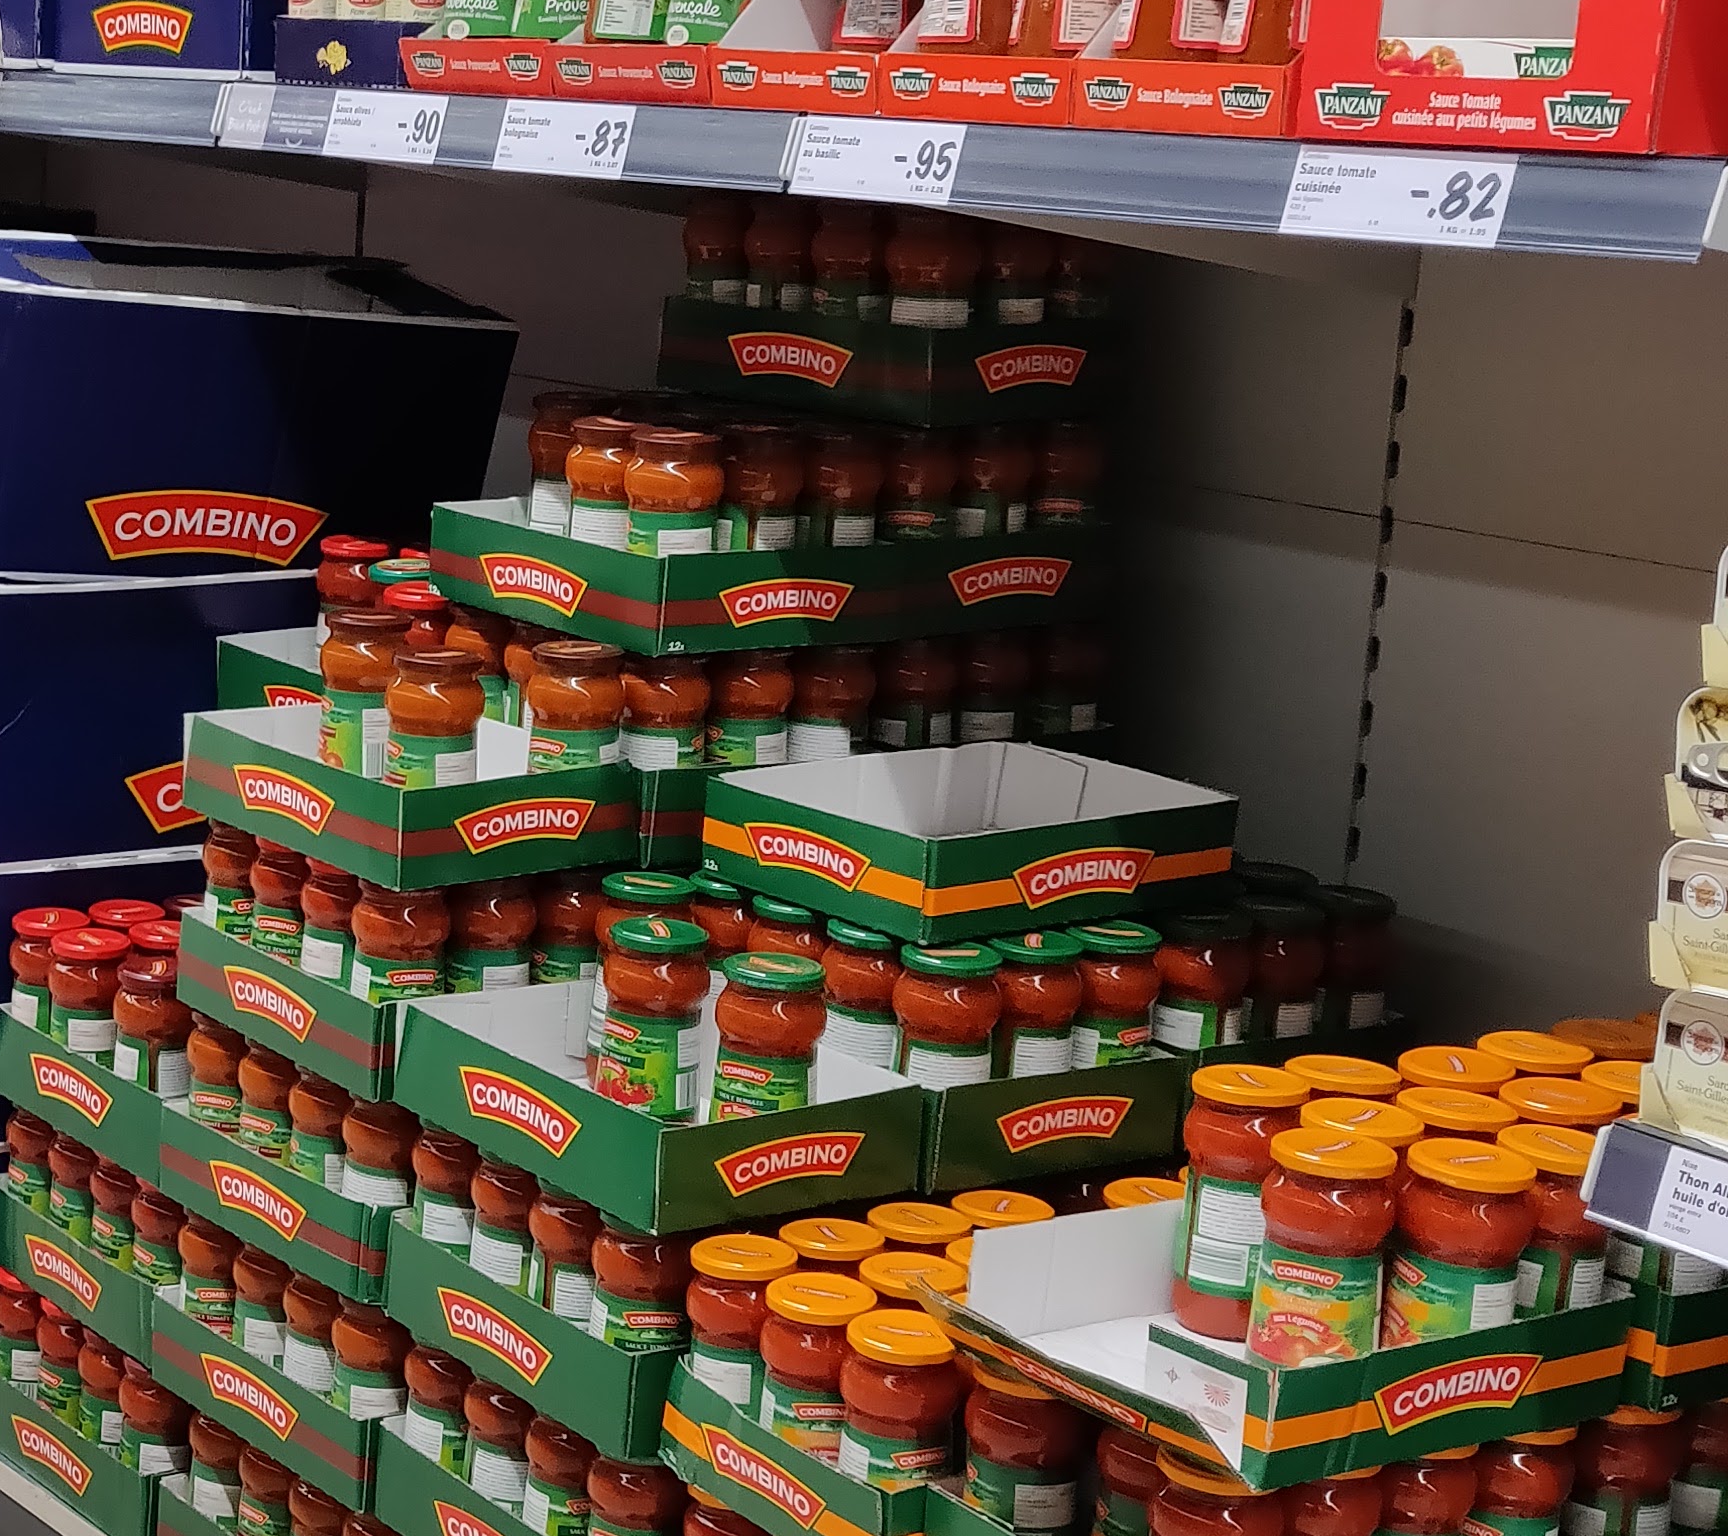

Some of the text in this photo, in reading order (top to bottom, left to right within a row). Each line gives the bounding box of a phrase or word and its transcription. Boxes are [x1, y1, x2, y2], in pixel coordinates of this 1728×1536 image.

[105, 13, 180, 40] COMBINO
[414, 55, 539, 72] PANZANI PANZANI
[559, 62, 695, 79] PANZANI PANZANI
[721, 71, 755, 85] PANZANI
[830, 75, 866, 90] PANZANI
[894, 77, 1056, 98] PANZANI Sauce Bolognaise PANZANI
[336, 103, 372, 117] Sauce olives
[1088, 83, 1270, 110] PANZANI Sauce Bolognaise PANZANI
[1324, 95, 1621, 125] PANZANI PANZANI
[1429, 91, 1502, 109] Sauce Tomate
[397, 109, 441, 145] -.90
[504, 127, 538, 141] bolognaise
[507, 114, 551, 129] Sauce tomate
[1391, 108, 1537, 134] cuisinée aux petits légumes
[575, 120, 628, 157] -.87
[806, 132, 861, 148] Sauce tomate
[803, 146, 841, 161] au basilic
[894, 139, 958, 182] -.95
[1299, 162, 1377, 180] Sauce tomate
[1294, 179, 1342, 195] cuisinée
[1410, 170, 1503, 222] -.82
[742, 344, 836, 377] COMBINO
[989, 354, 1073, 379] COMBINO
[115, 508, 296, 546] COMBINO
[734, 589, 836, 616] COMBINO
[759, 834, 854, 878] COMBINO
[1030, 859, 1136, 894] COMBINO
[232, 981, 308, 1034] COMBINO
[38, 1068, 105, 1118] COMBINO
[471, 1084, 569, 1147] COMBINO
[1011, 1107, 1114, 1143] COMBINO
[734, 1143, 847, 1185] COMBINO
[1682, 1159, 1698, 1172] Nixe
[1679, 1171, 1708, 1191] Thon
[1673, 1188, 1705, 1209] huile
[1277, 1266, 1335, 1286] COMBINO
[449, 1306, 541, 1374] COMBINO
[1393, 1366, 1521, 1415] COMBINO
[715, 1443, 810, 1520] COMBINO
